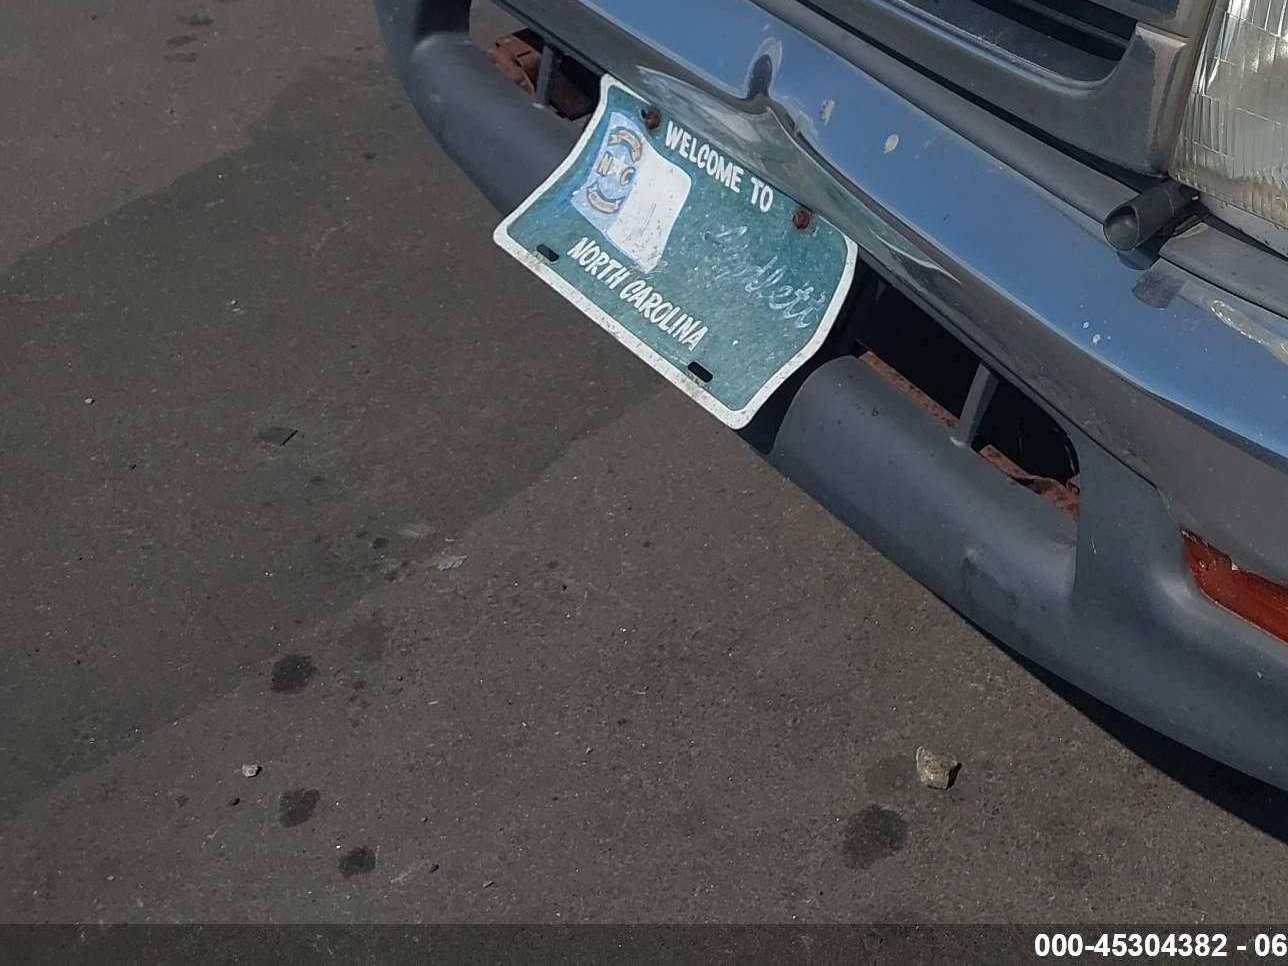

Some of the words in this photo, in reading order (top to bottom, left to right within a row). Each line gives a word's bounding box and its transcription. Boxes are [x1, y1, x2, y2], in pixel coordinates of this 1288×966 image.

[597, 150, 613, 177] N
[620, 166, 636, 186] C
[665, 120, 744, 193] WELCOME
[750, 176, 774, 212] TO
[567, 237, 631, 290] NORTH
[620, 280, 708, 352] CAROLINA
